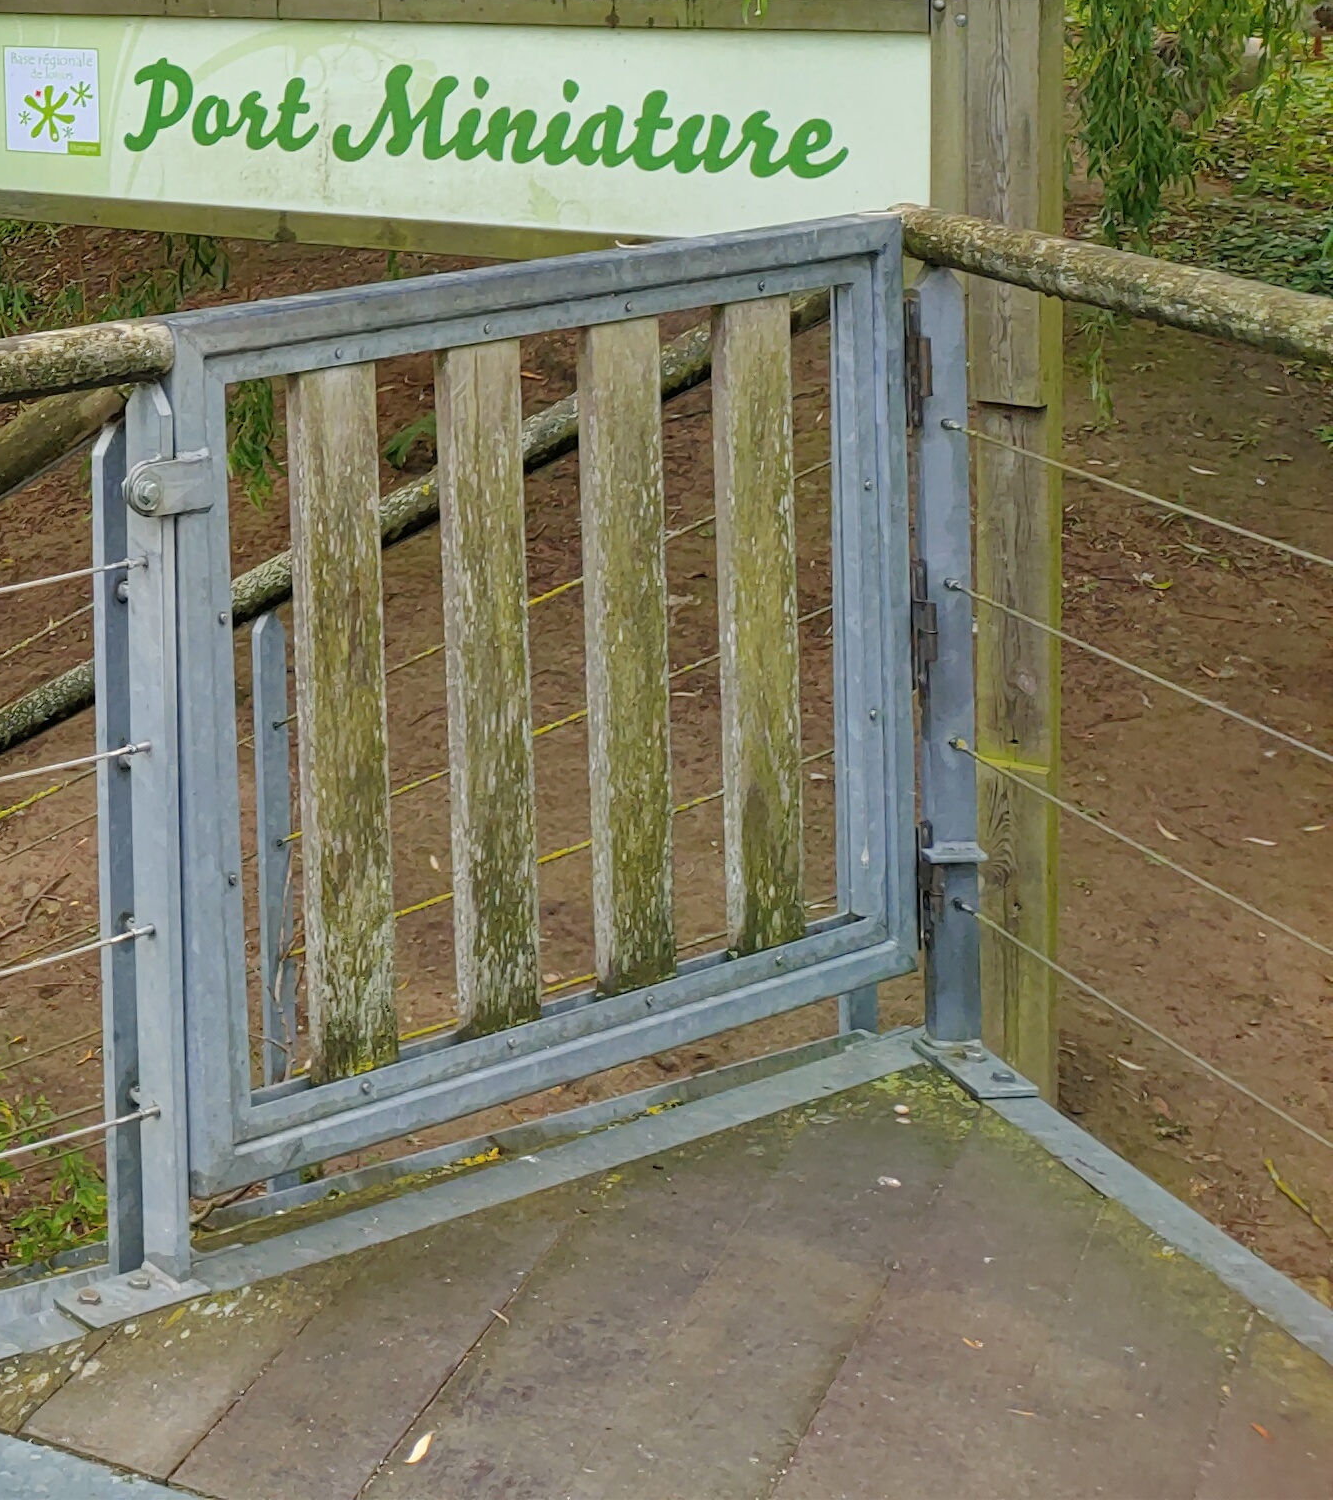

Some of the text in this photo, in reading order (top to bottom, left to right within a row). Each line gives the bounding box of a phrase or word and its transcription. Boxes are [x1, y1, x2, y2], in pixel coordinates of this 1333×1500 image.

[10, 51, 93, 70] Base régionale
[124, 57, 849, 179] Port Miniature
